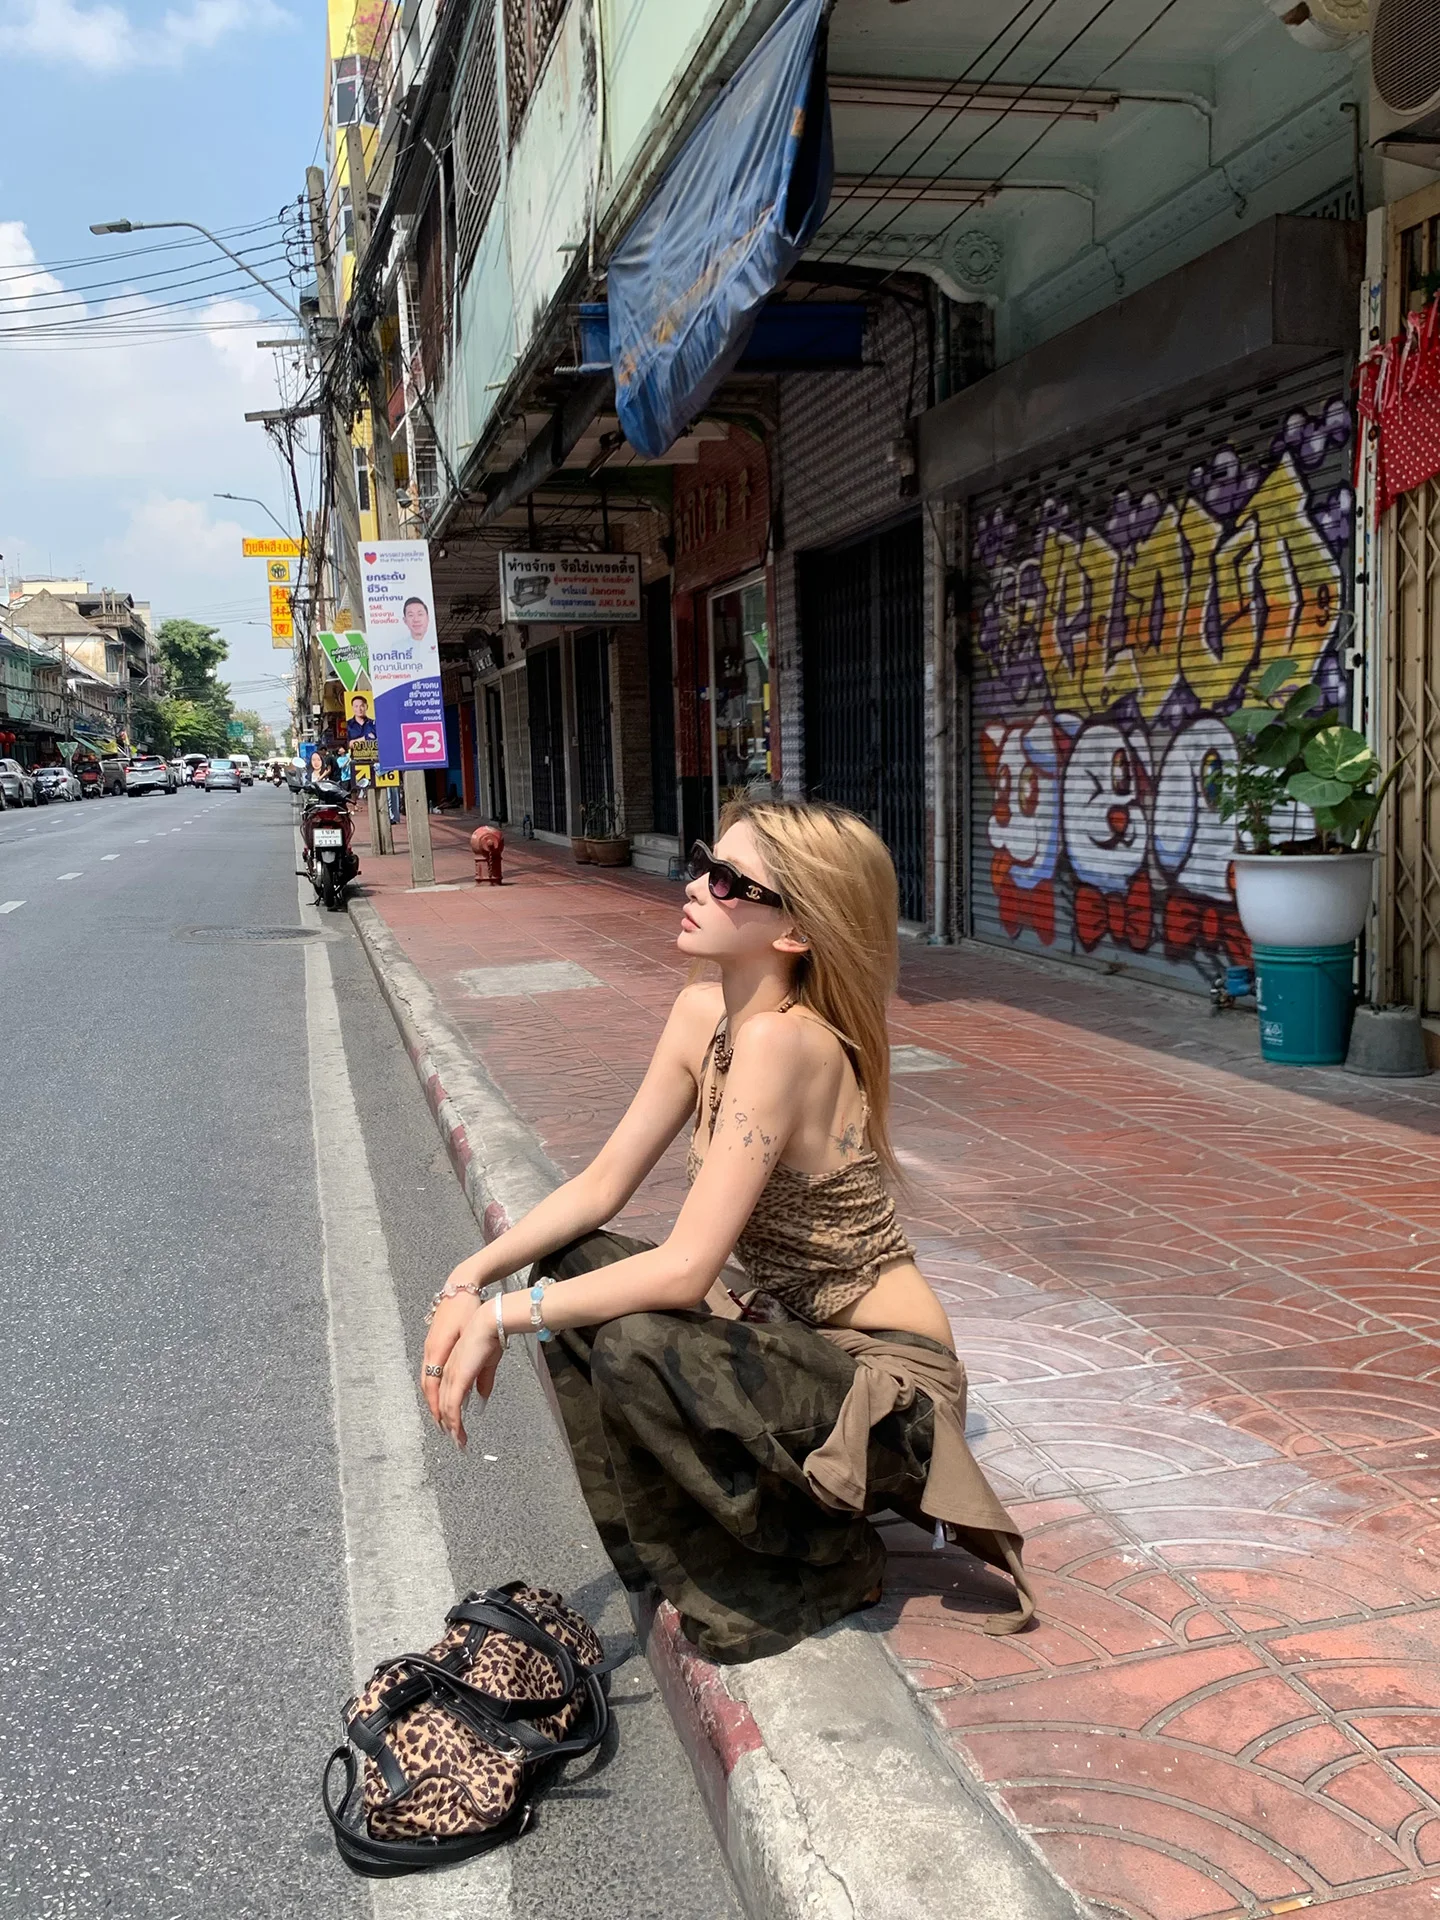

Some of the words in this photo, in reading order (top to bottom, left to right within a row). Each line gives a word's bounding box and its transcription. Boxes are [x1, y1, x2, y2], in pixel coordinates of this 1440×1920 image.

[366, 571, 406, 581] ยกระดับ
[367, 584, 388, 593] ชีวิต
[590, 587, 626, 595] Janome
[368, 594, 404, 602] คนทำงาน
[372, 647, 413, 661] เอกสิทธิ์
[412, 681, 439, 690] สร้างคน
[409, 690, 439, 698] สร้างงาน
[404, 698, 440, 707] สร้างอาชีพ
[407, 730, 441, 754] 23
